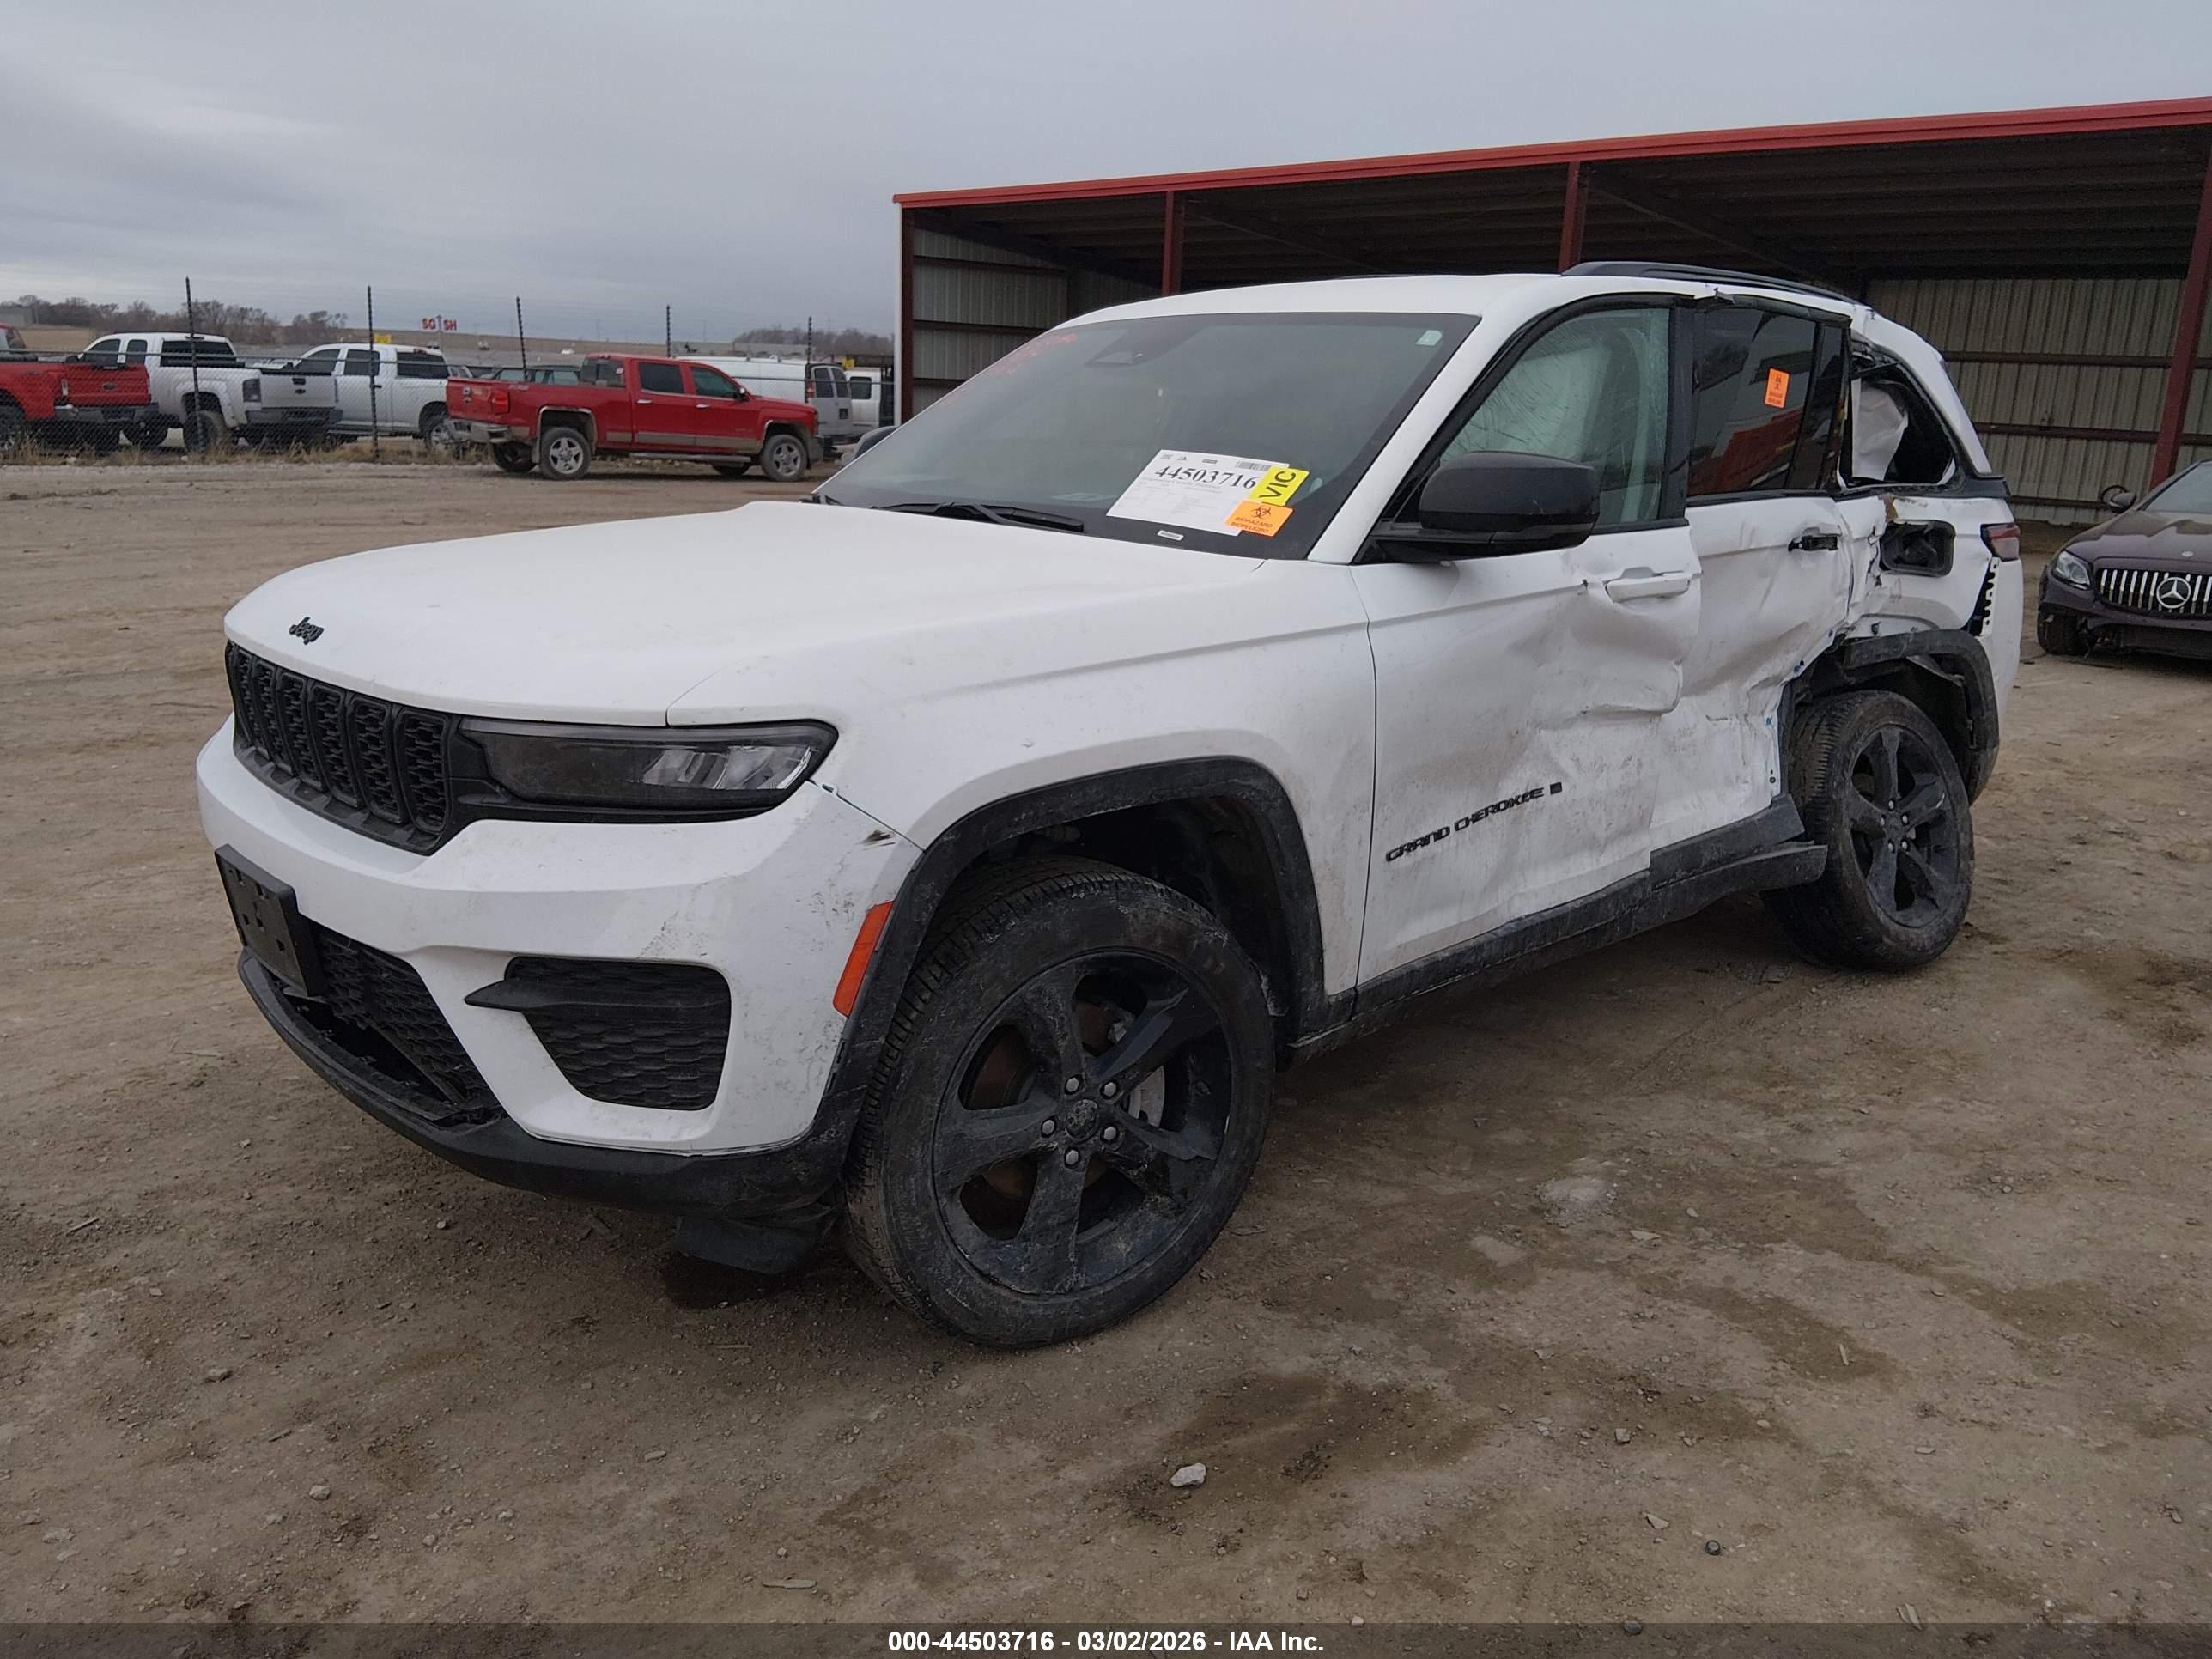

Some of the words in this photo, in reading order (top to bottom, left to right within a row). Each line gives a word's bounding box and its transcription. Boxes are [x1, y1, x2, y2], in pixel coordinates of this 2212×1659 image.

[1154, 465, 1259, 489] 44503716
[1258, 471, 1297, 498] VIC
[289, 617, 325, 646] Jeep
[1385, 826, 1450, 862] GRAND
[1454, 787, 1545, 832] CHEROKEE
